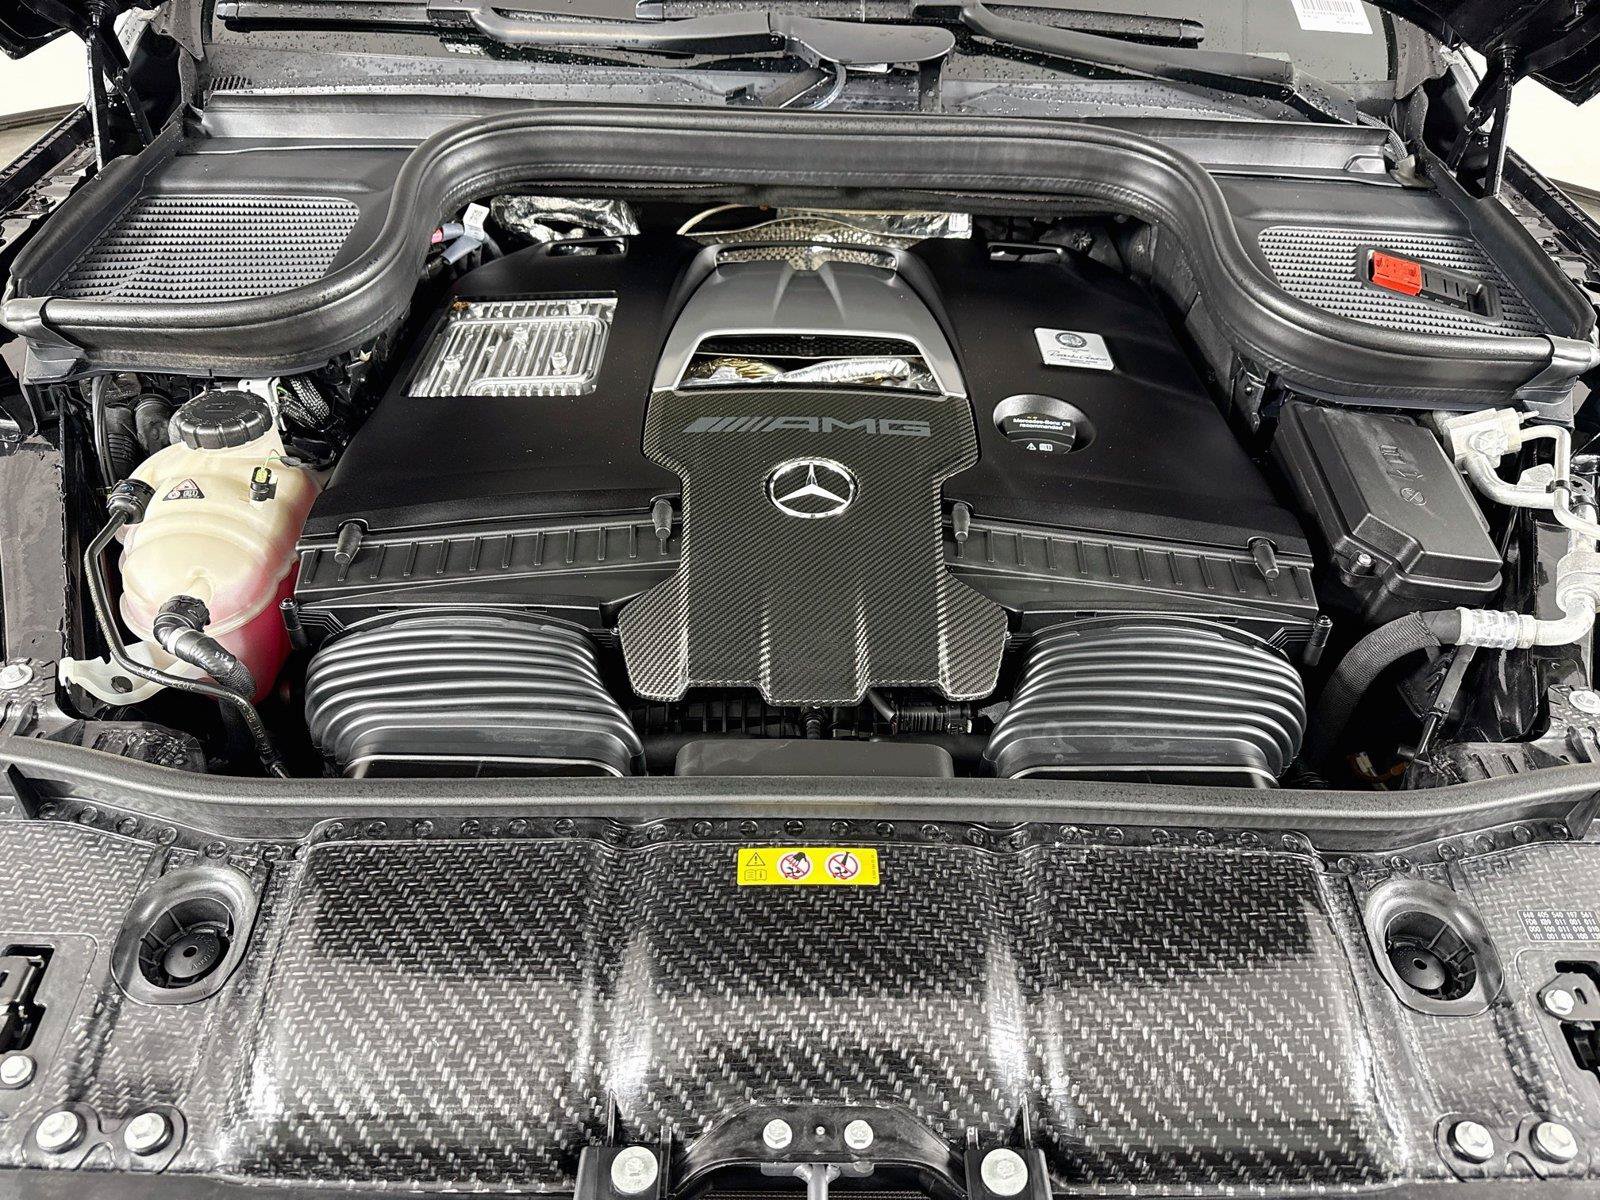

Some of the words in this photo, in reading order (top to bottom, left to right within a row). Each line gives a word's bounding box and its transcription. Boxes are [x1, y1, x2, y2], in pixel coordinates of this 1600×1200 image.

[1013, 417, 1060, 426] Mercedes-Benz
[760, 416, 932, 437] AMG
[1019, 422, 1064, 431] recommended
